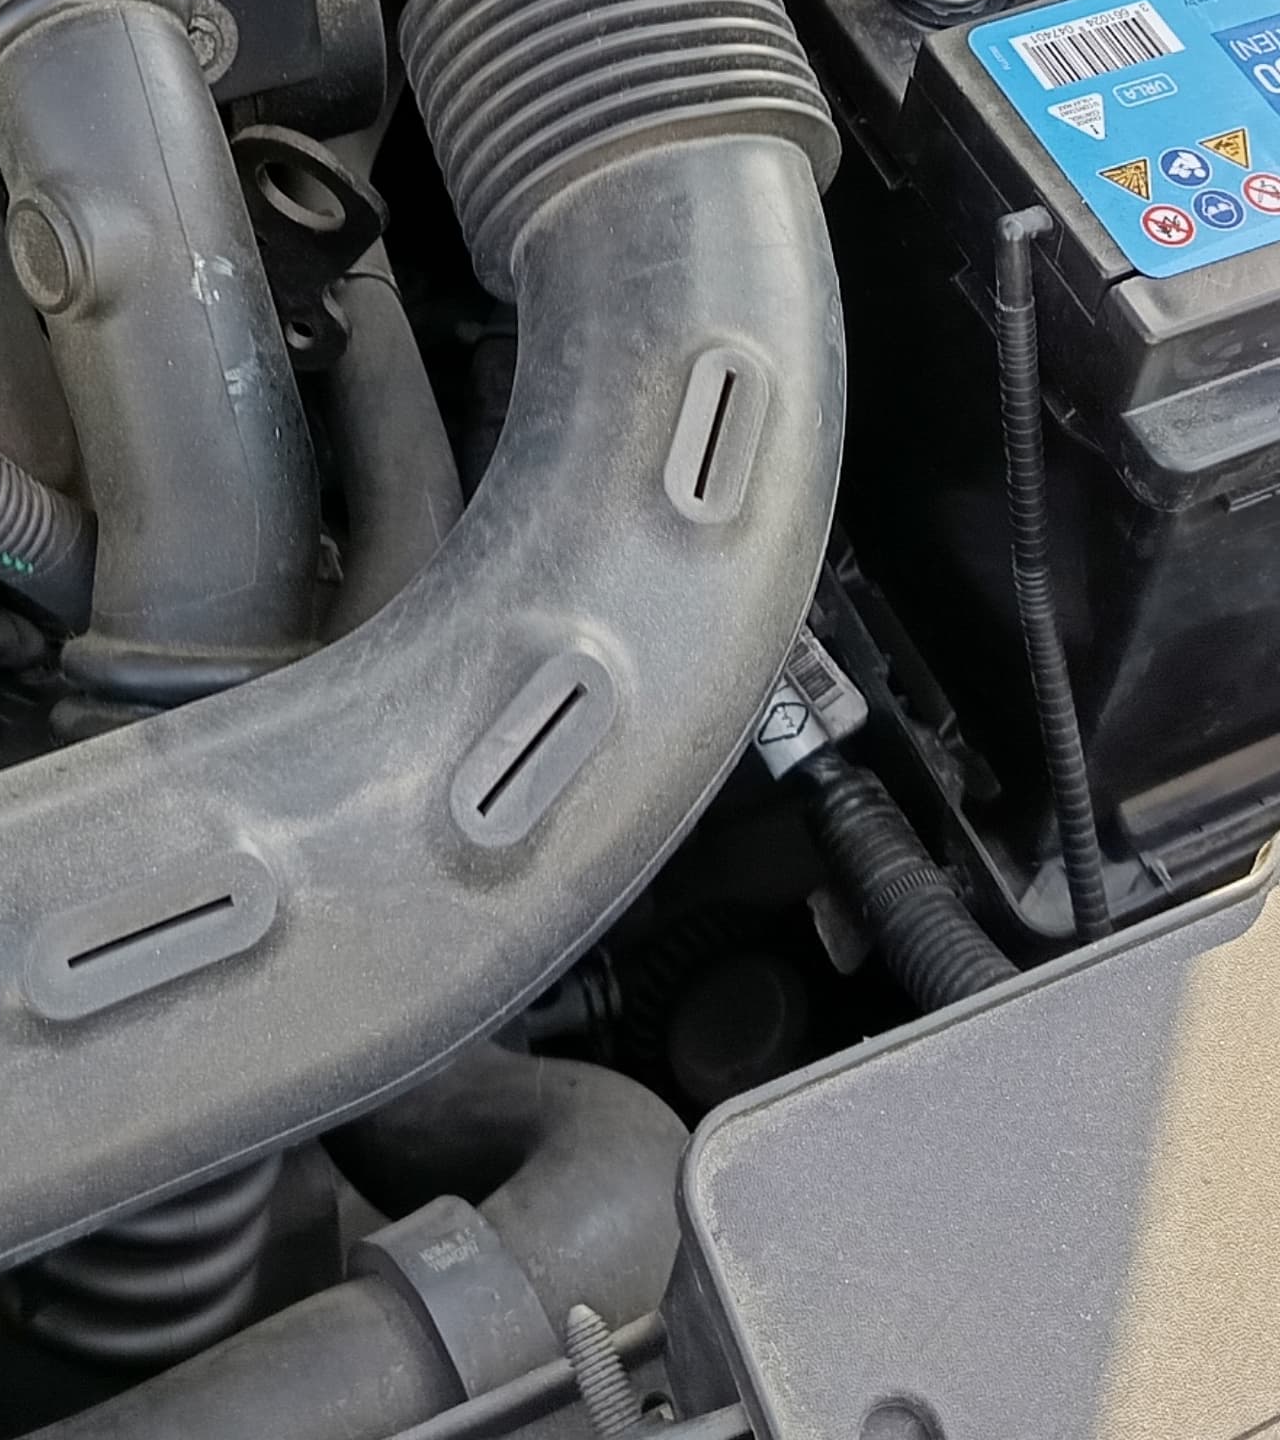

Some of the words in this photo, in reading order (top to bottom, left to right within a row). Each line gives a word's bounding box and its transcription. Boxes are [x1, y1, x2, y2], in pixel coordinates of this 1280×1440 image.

[1083, 6, 1131, 29] 661024
[1136, 1, 1151, 13] 3
[1027, 23, 1075, 45] 047401
[1120, 77, 1168, 101] VRLA
